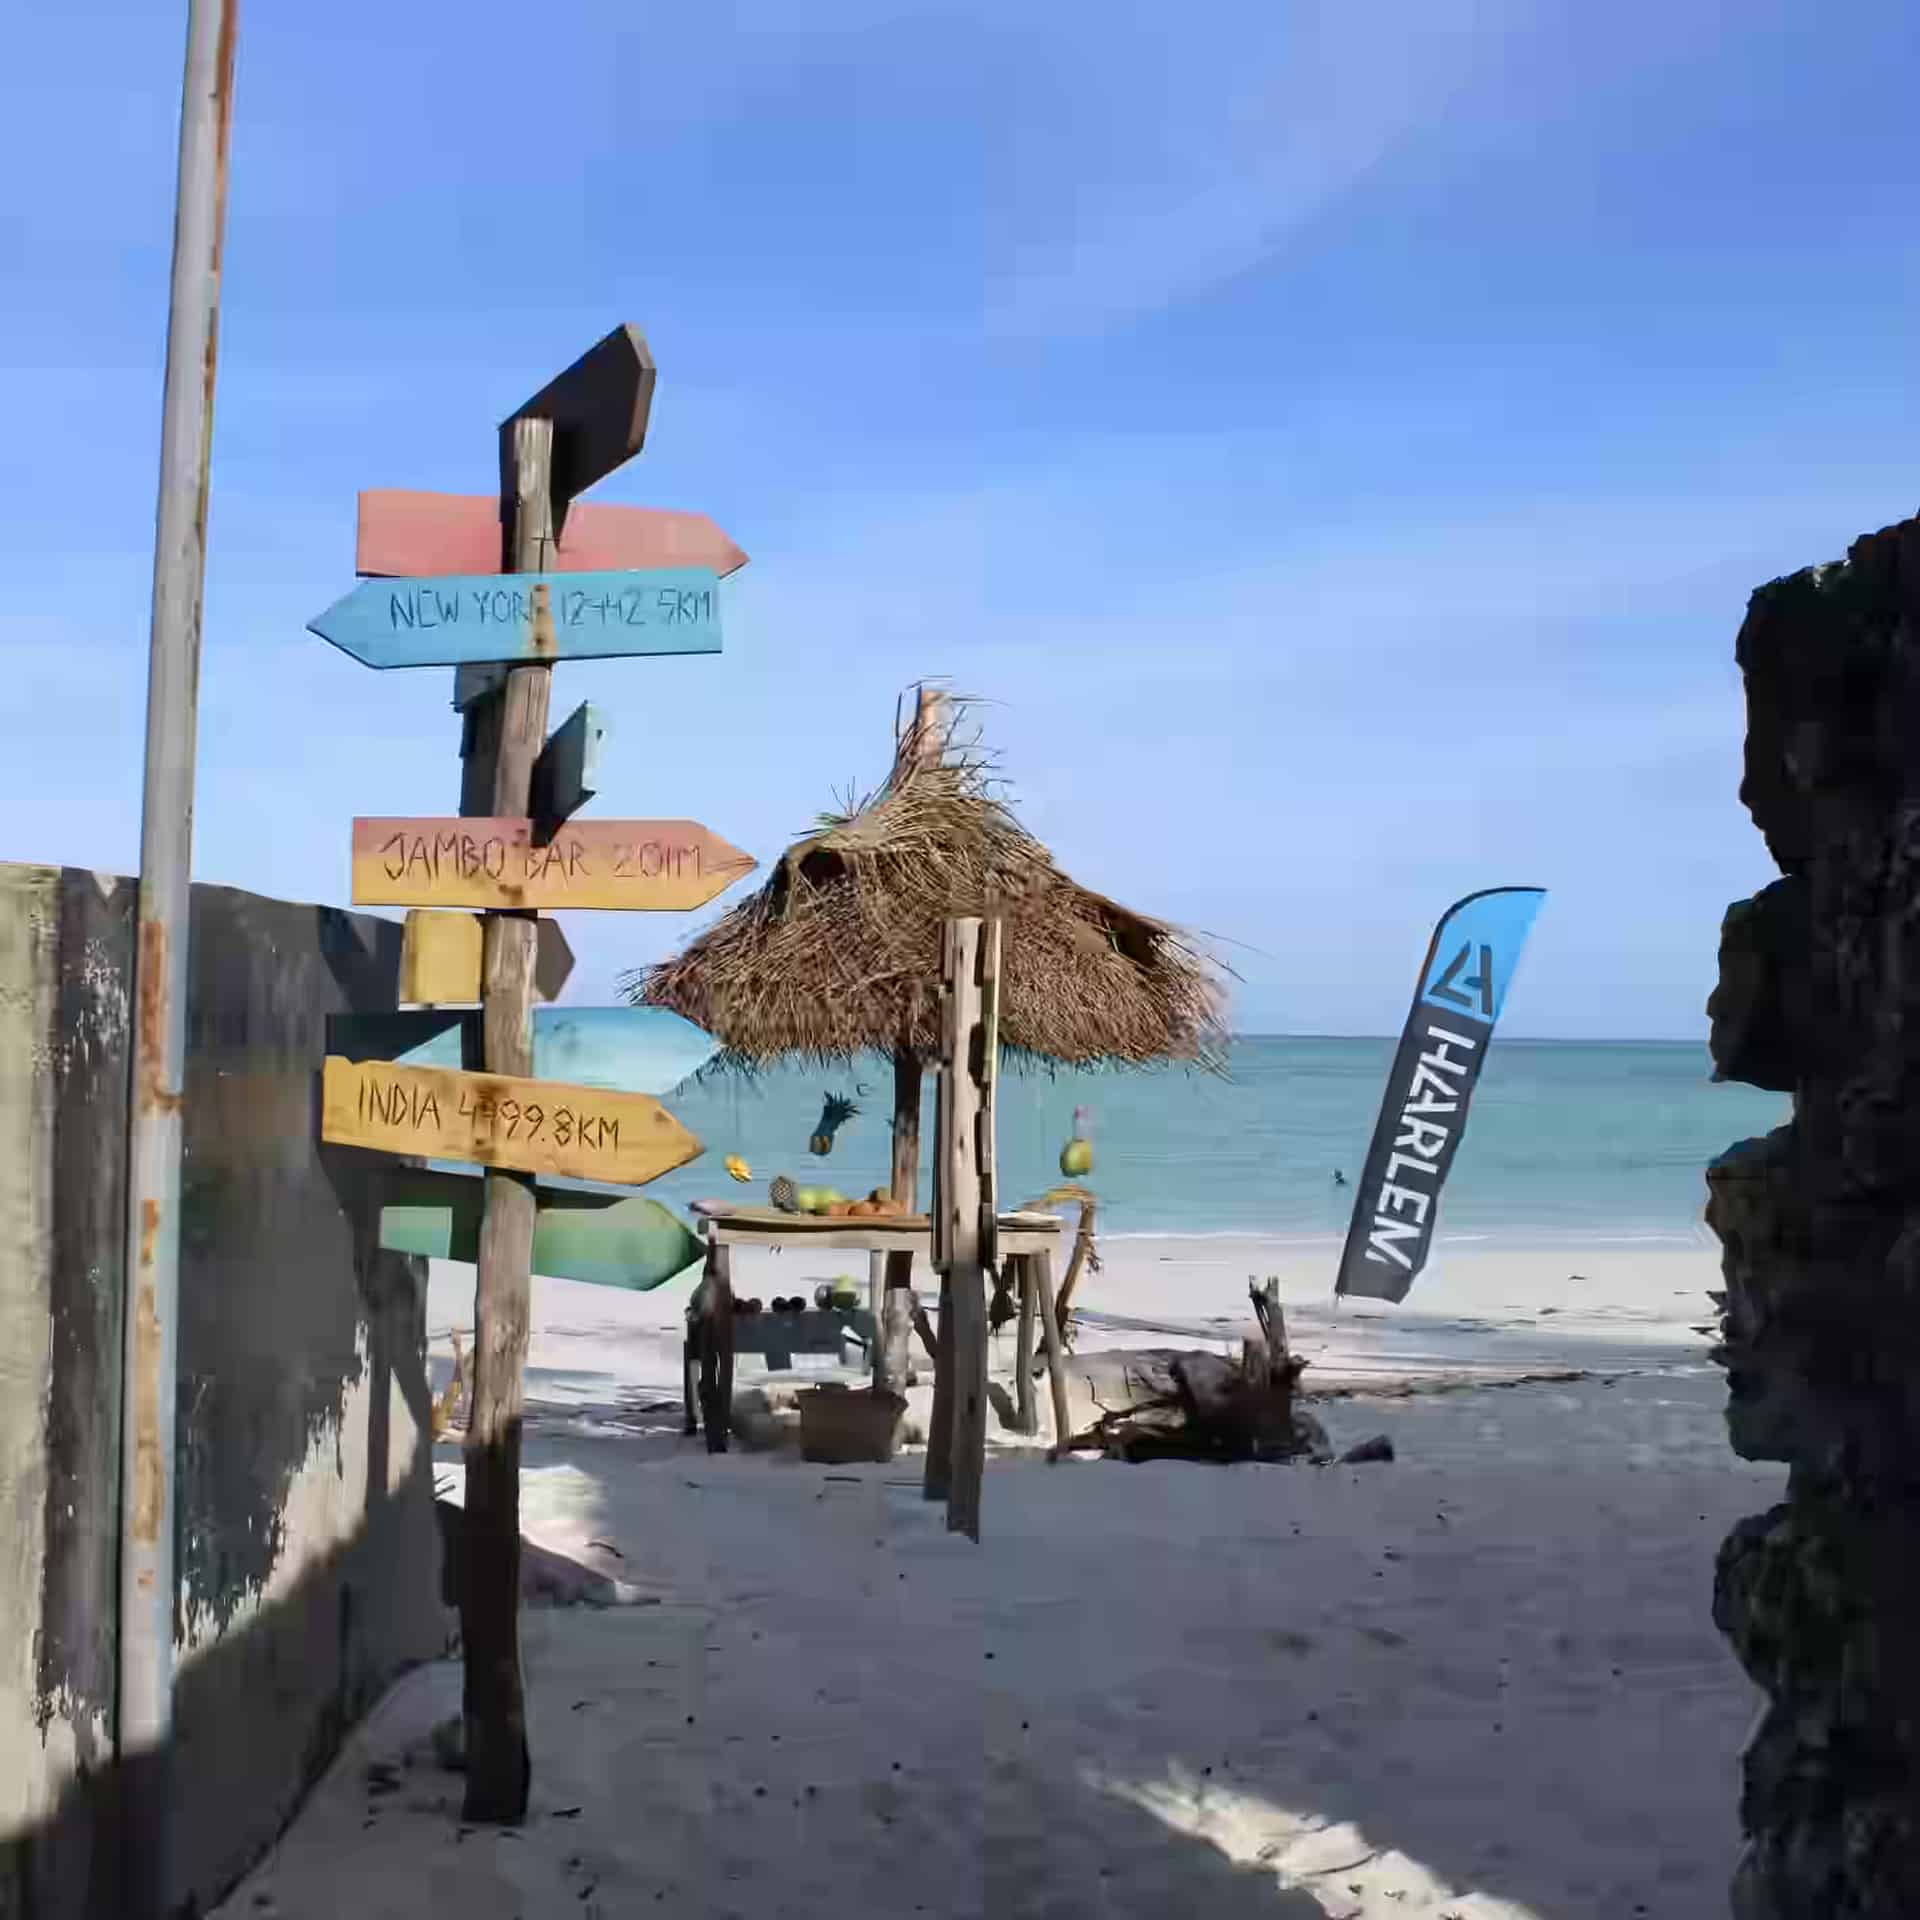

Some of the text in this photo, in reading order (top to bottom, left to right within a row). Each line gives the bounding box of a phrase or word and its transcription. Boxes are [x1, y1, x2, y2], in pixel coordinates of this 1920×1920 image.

[390, 586, 459, 630] NEW
[380, 832, 504, 880] JAMBO
[524, 841, 591, 887] BAR
[358, 1075, 441, 1131] INDIA
[1364, 1025, 1476, 1270] HARLEM
